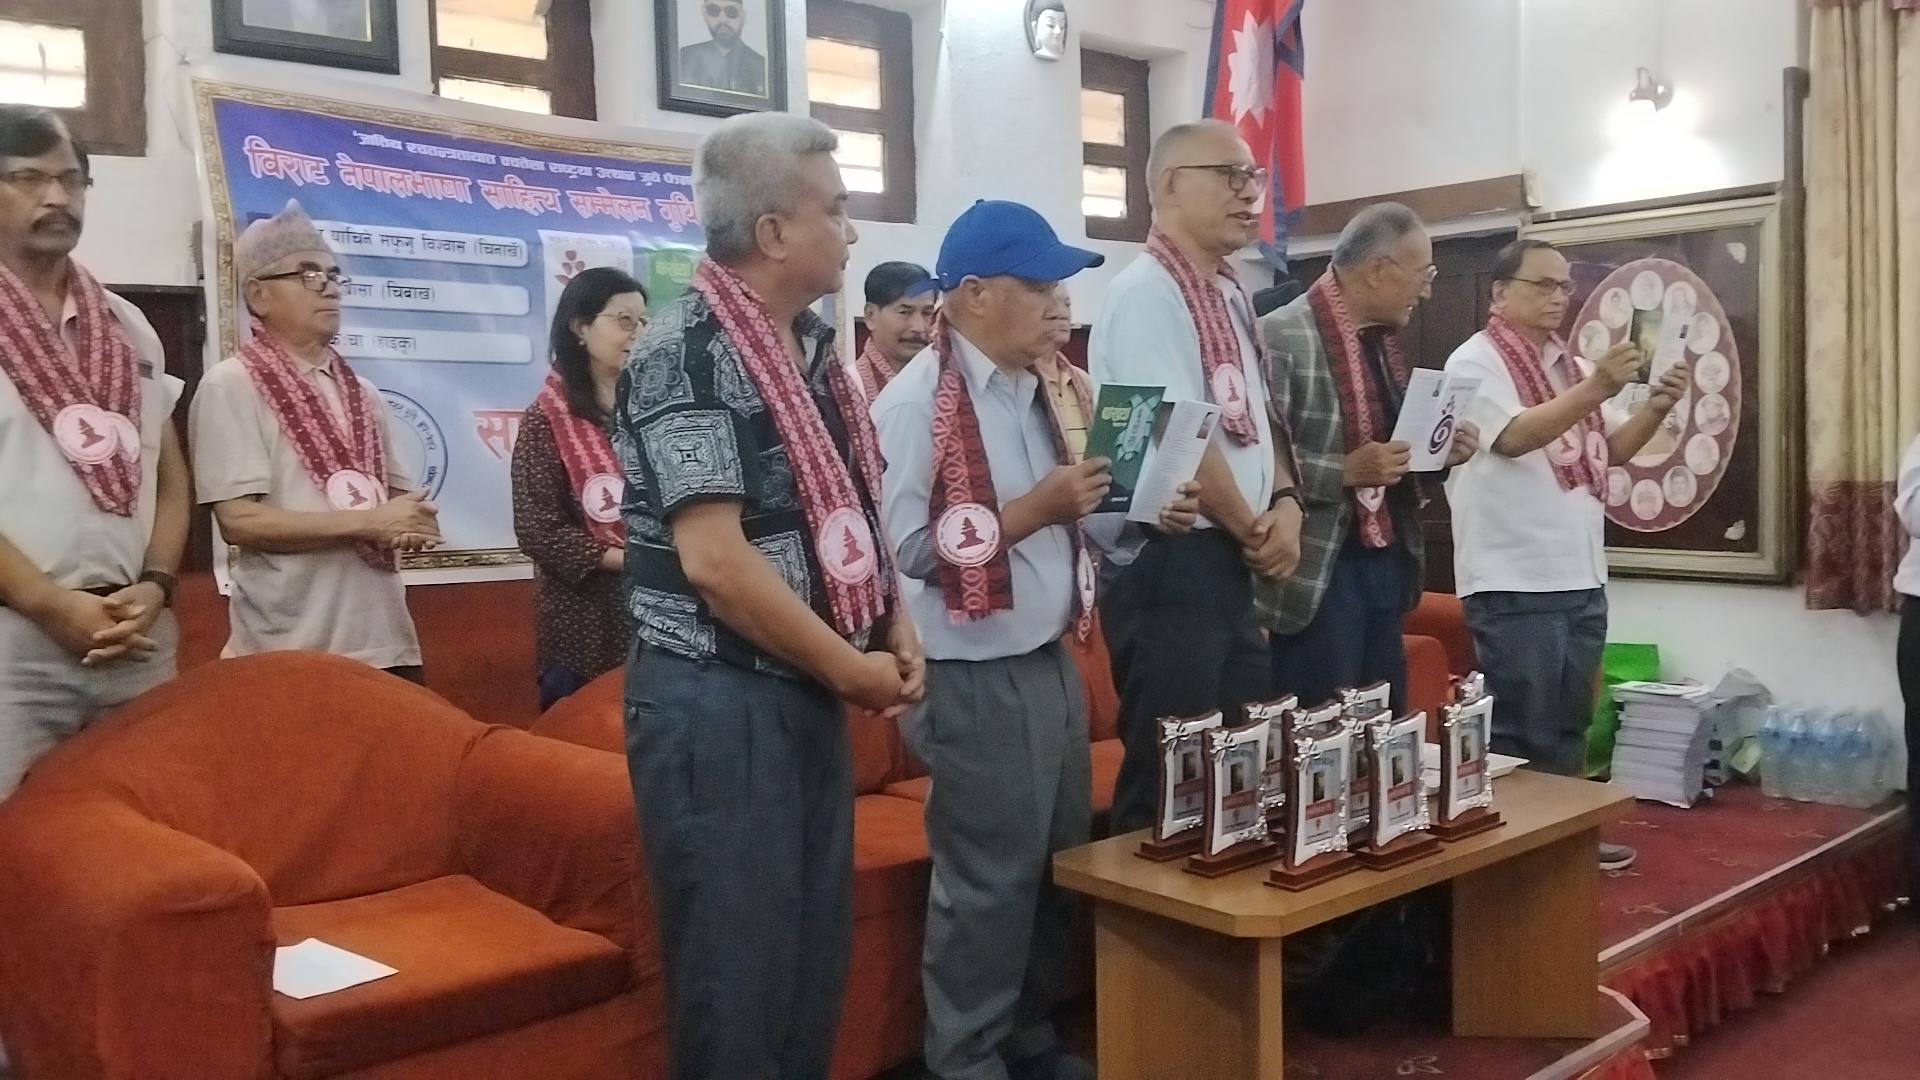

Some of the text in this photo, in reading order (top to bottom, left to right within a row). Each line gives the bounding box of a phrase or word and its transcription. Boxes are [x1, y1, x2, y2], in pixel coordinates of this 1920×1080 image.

[243, 135, 330, 186] विराट
[336, 152, 473, 204] नेपालभाषा
[476, 174, 563, 216] साहित्य
[565, 187, 653, 224] सम्मेलन
[422, 233, 466, 253] विश्वास
